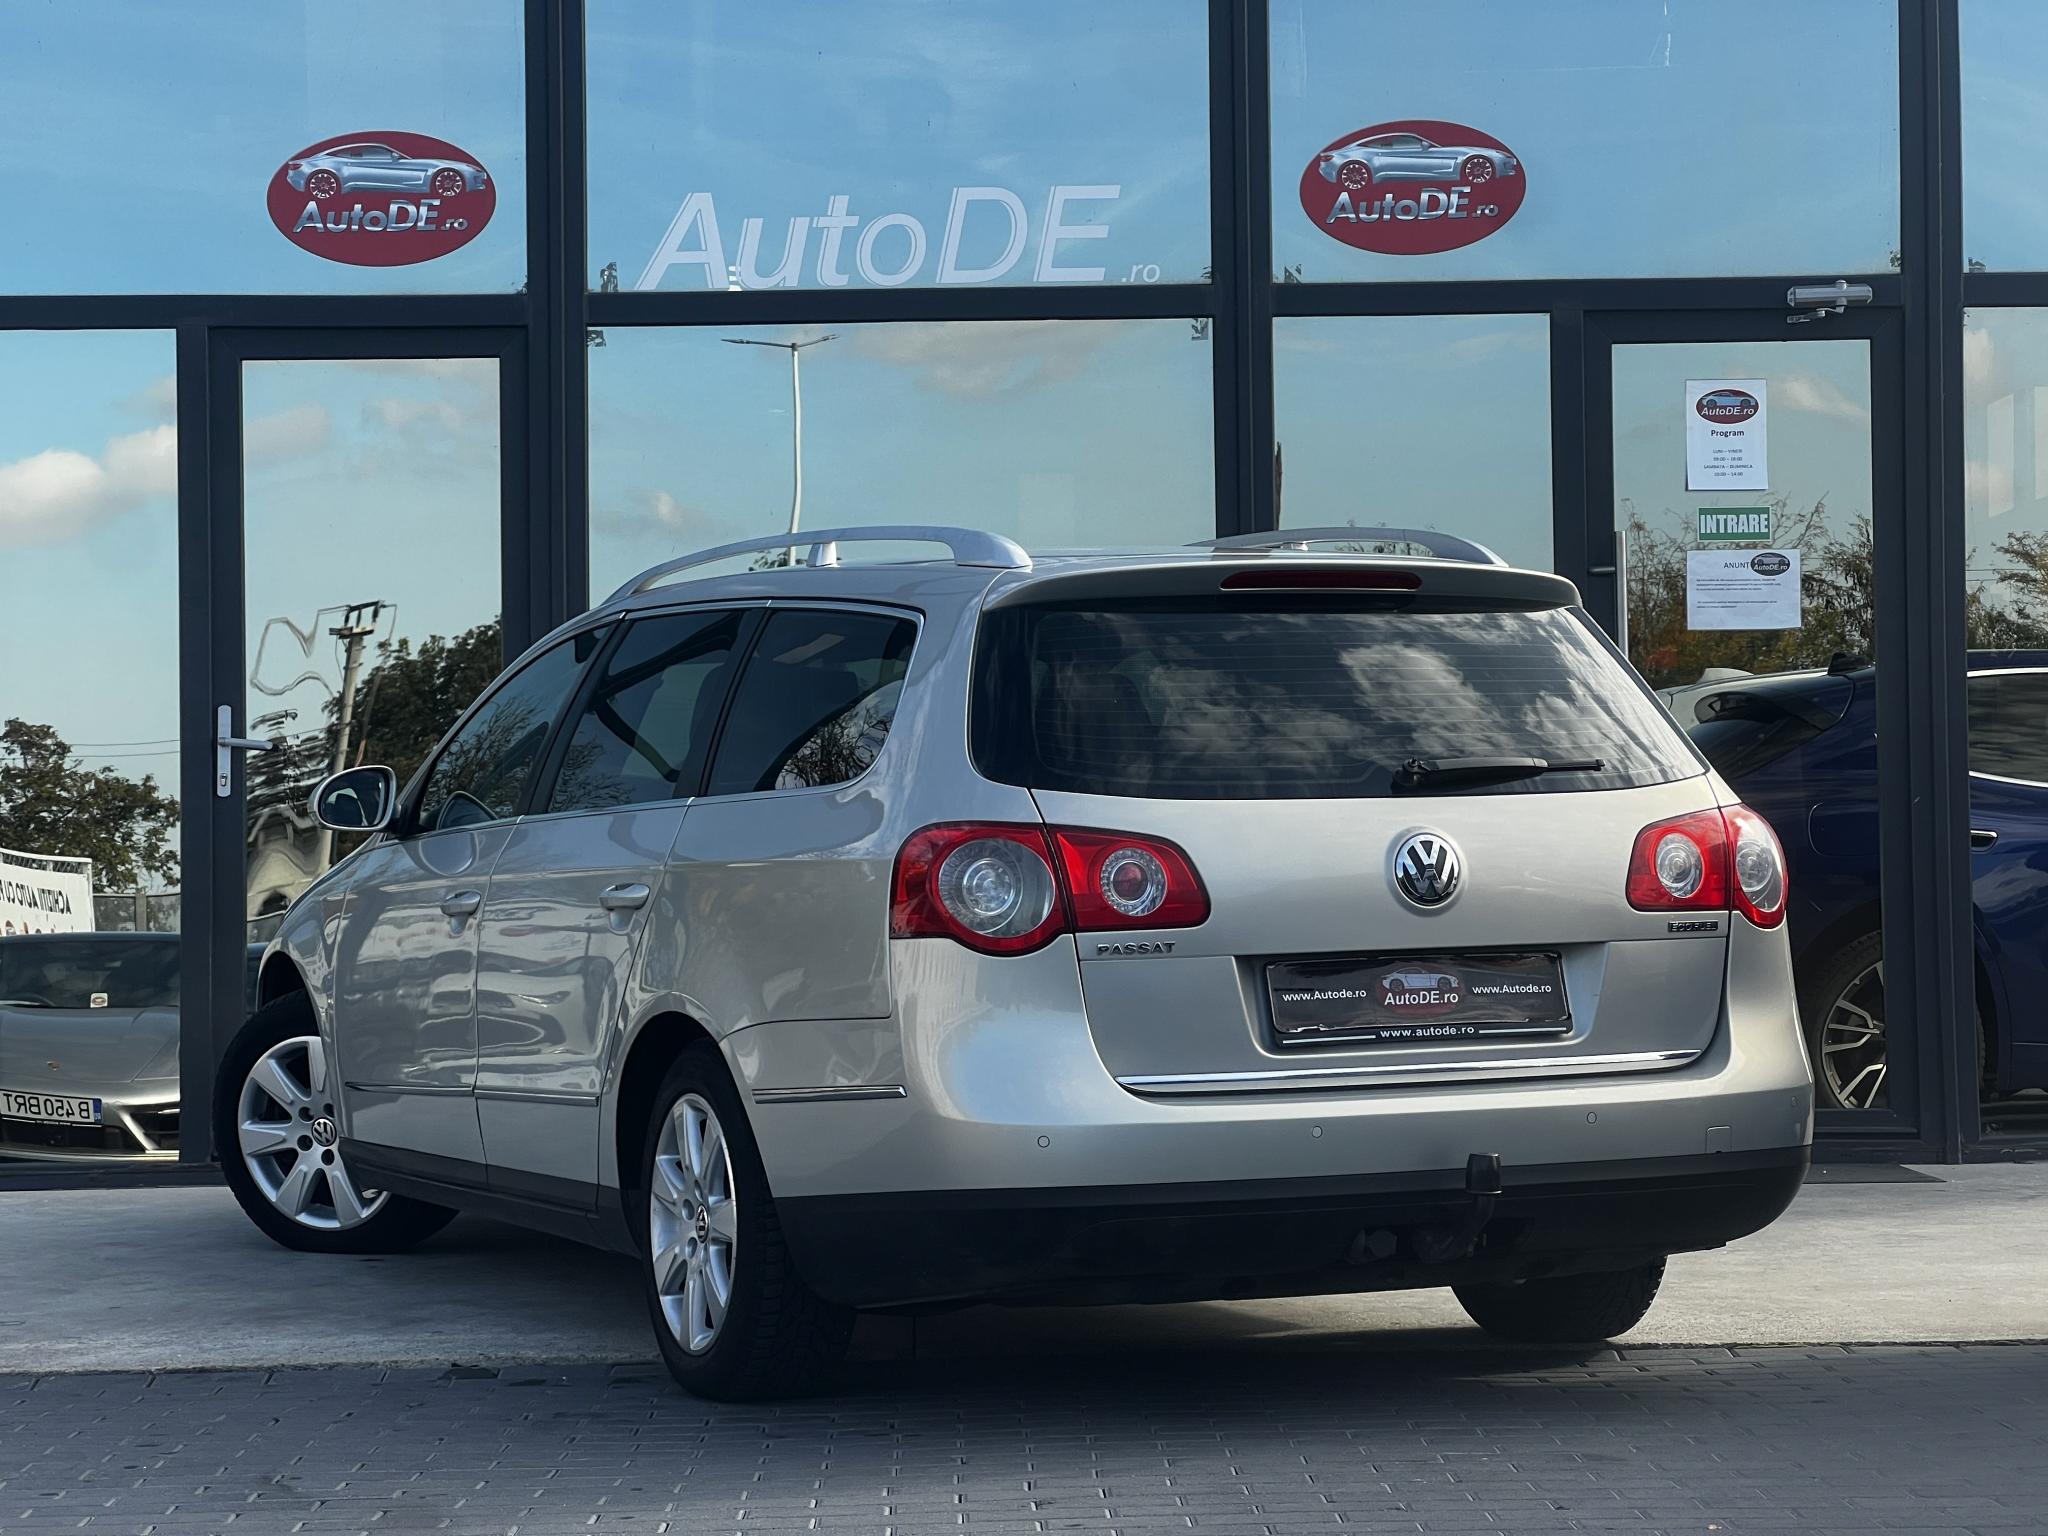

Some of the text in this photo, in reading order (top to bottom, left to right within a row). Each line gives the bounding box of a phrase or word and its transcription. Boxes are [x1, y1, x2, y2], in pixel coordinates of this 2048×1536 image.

[1701, 407, 1755, 416] AutoDE.ro
[1711, 430, 1744, 438] Program
[1700, 514, 1768, 534] INTRARE
[1753, 562, 1788, 571] AutoDE.ro
[1097, 941, 1176, 956] PASSAT
[1282, 988, 1367, 1002] www.Autode.ro
[1472, 983, 1552, 995] www.Autode.ro
[1384, 990, 1459, 1006] AutoDE.ro
[1380, 1025, 1475, 1039] www.autode.ro
